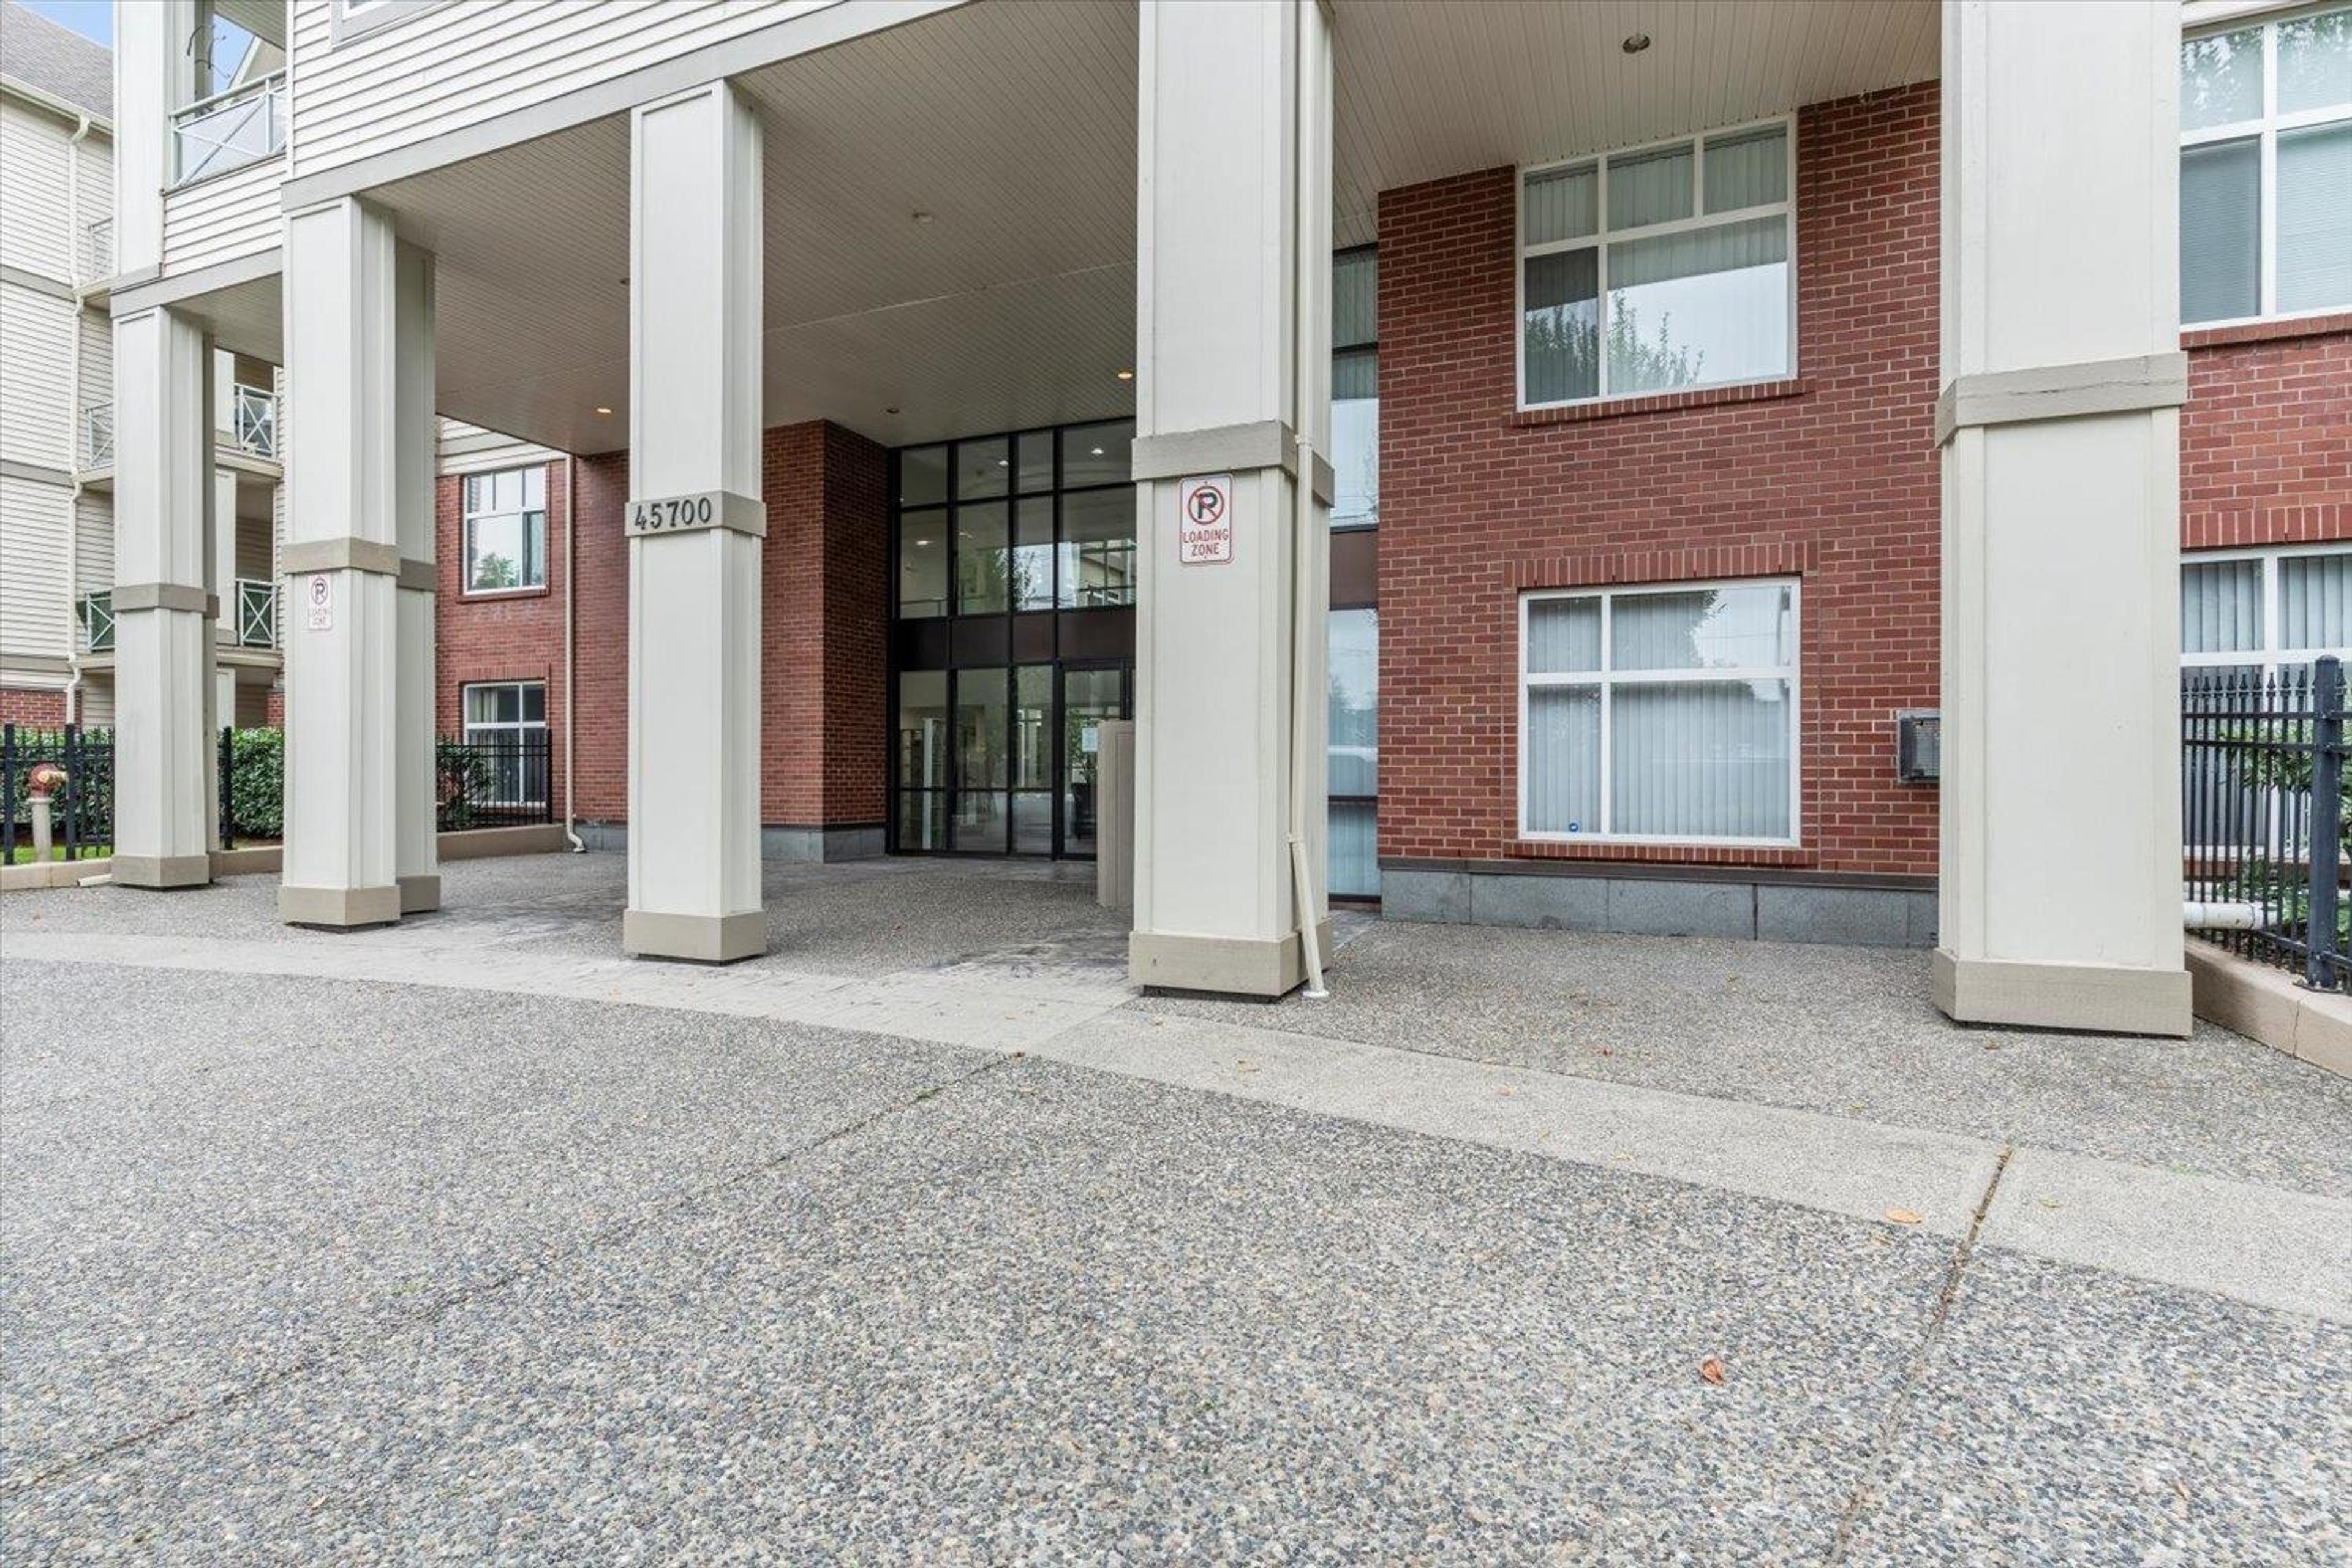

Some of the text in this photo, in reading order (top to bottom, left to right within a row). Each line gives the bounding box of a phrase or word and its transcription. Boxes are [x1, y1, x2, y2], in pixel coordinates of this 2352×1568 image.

[635, 497, 712, 530] 45700
[1184, 529, 1229, 543] LOADING
[1191, 543, 1219, 556] ZONE
